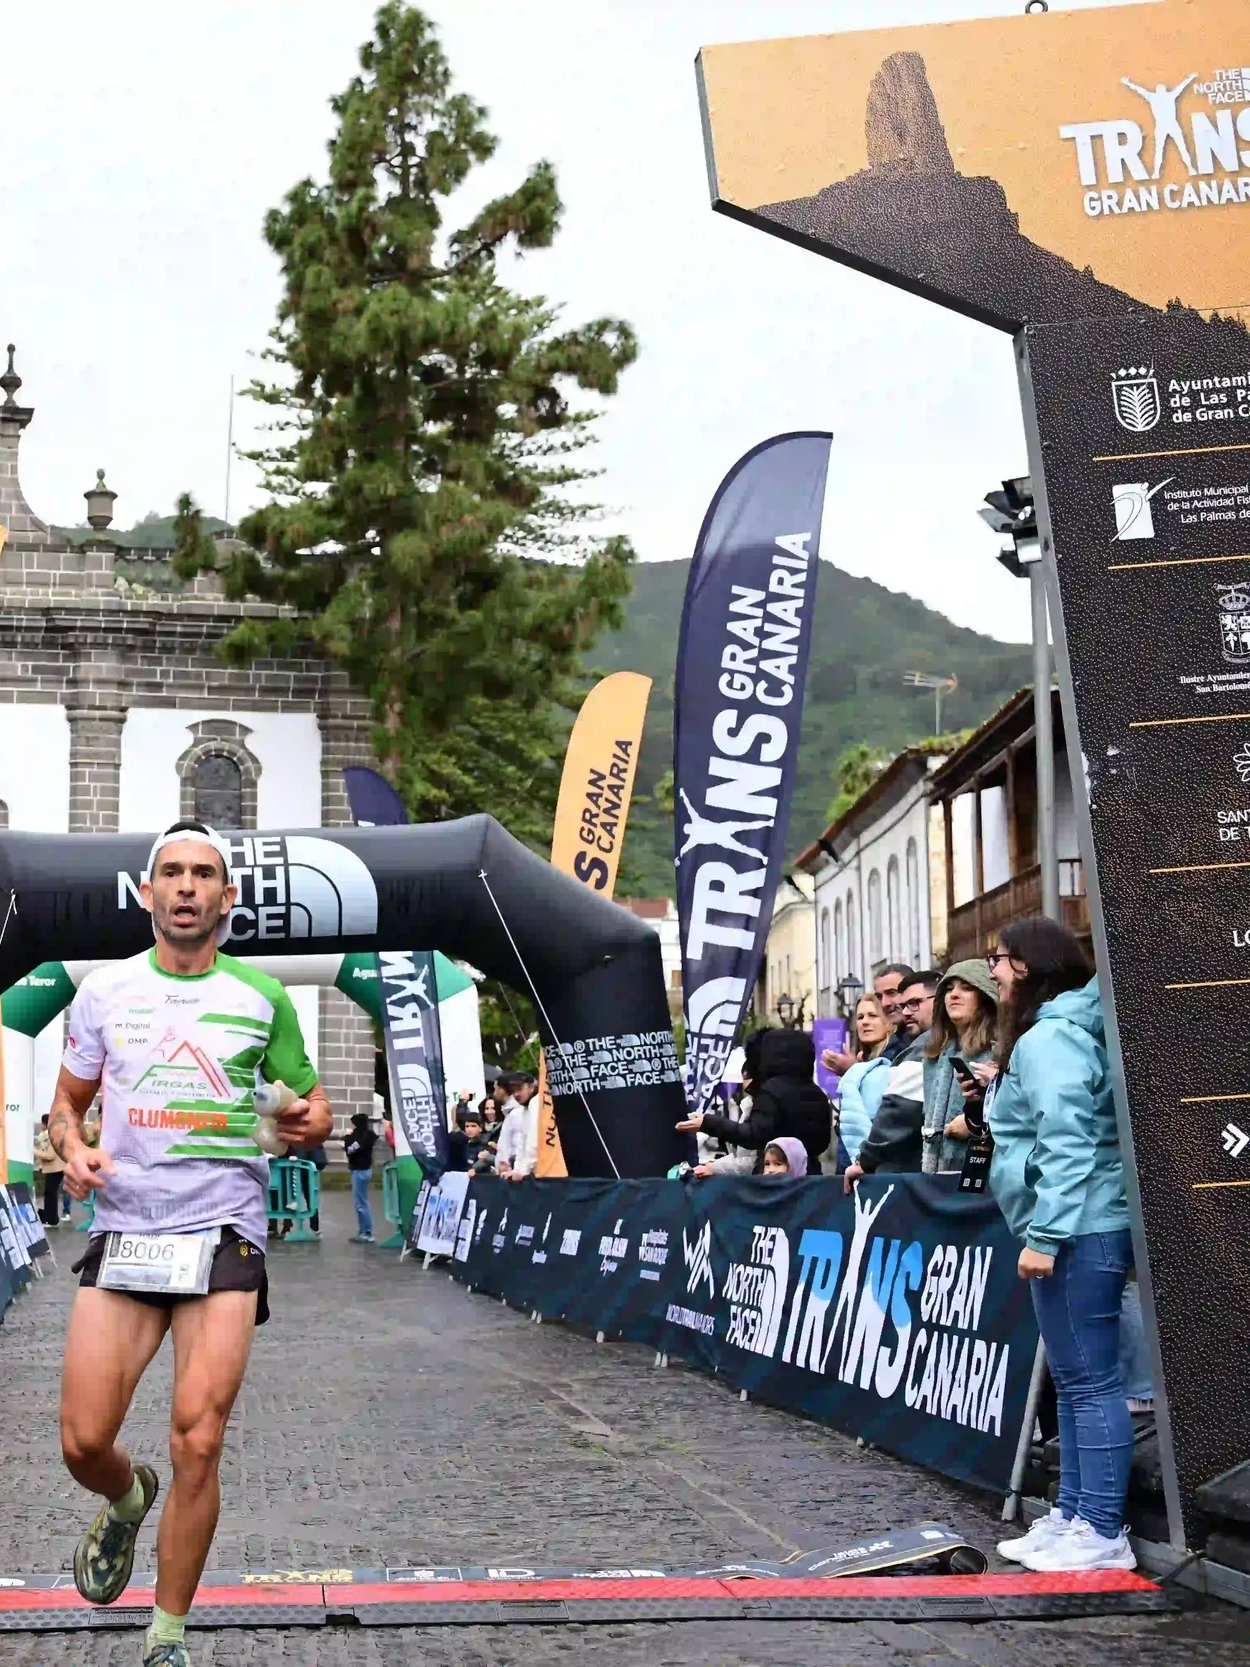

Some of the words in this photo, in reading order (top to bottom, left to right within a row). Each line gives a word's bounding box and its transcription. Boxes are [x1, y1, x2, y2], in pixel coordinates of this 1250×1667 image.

[1214, 68, 1241, 82] THE
[1193, 80, 1243, 97] NORTH
[1208, 92, 1244, 105] FACE
[1083, 186, 1160, 217] GRAN
[1170, 393, 1191, 408] de
[1200, 392, 1228, 405] Las
[1172, 409, 1192, 423] de
[1196, 407, 1234, 421] Gran
[1164, 489, 1202, 500] Instituto
[1204, 484, 1249, 496] Municipal
[1167, 502, 1180, 511] de
[1182, 501, 1190, 510] la
[1191, 497, 1235, 509] Actividad
[1180, 513, 1198, 524] Las
[1200, 511, 1236, 522] Palmas
[755, 532, 812, 707] CANARIA
[718, 584, 766, 701] GRAN
[579, 767, 607, 845] GRAN
[596, 740, 633, 854] CANARIA
[1219, 827, 1241, 841] DE
[222, 837, 281, 866] HE
[117, 864, 286, 909] NTH
[230, 905, 286, 940] CE
[586, 1036, 617, 1050] THE
[640, 1031, 674, 1045] NORTH
[563, 1053, 589, 1068] THE
[613, 1045, 660, 1062] NORTH
[590, 1062, 629, 1078] FACE
[558, 1078, 601, 1095] NORTH
[626, 1072, 662, 1087] FACE
[969, 1156, 986, 1164] STAFF
[121, 1240, 175, 1261] 8006
[751, 1225, 777, 1265] THE
[722, 1263, 771, 1308] NORTH
[920, 1243, 993, 1331] GRAN
[726, 1304, 763, 1352] FACE
[905, 1328, 1010, 1437] CANARIA
